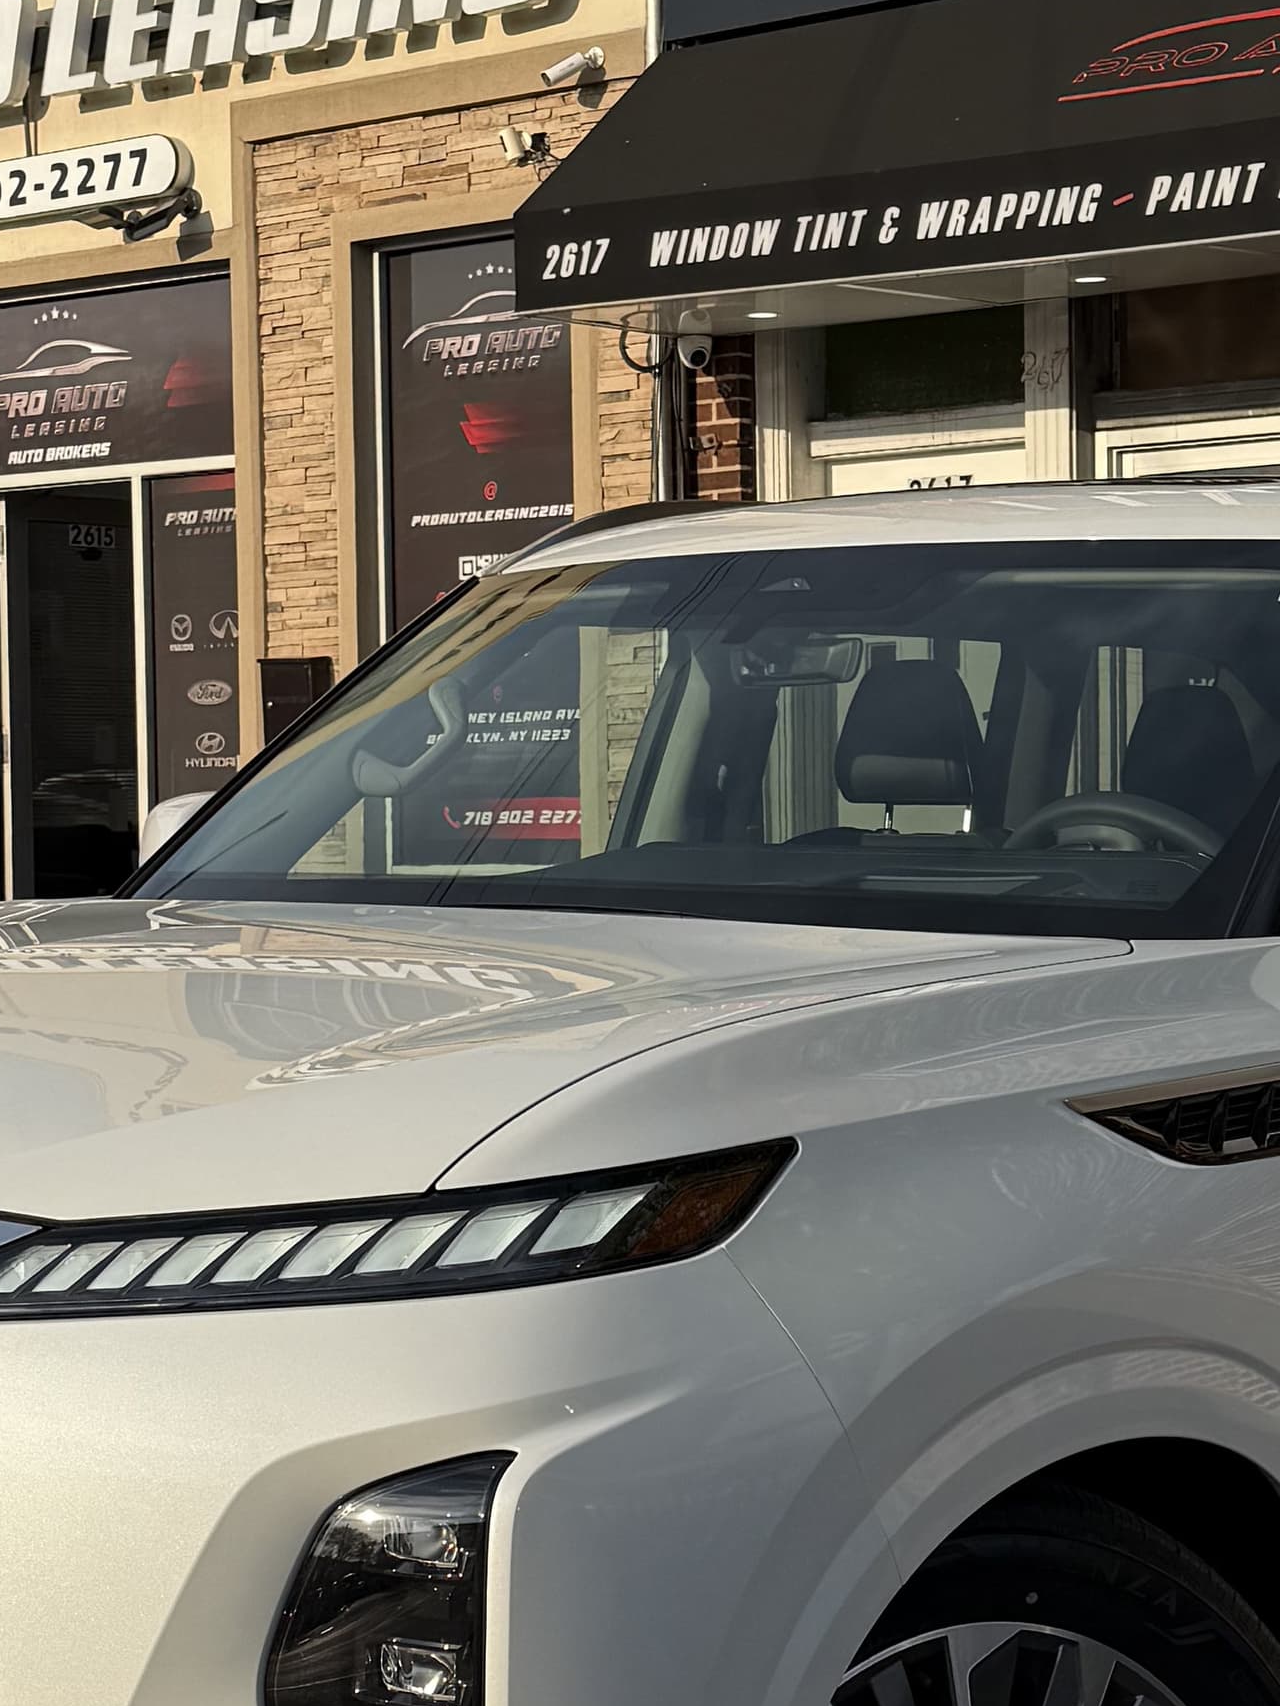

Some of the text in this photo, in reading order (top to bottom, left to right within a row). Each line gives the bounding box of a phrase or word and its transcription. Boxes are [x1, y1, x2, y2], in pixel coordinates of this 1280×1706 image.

[1072, 41, 1229, 84] PRO
[541, 237, 612, 281] 2617
[649, 218, 782, 269] WINDOW
[793, 208, 868, 254] TINT
[878, 205, 902, 245] &
[916, 183, 1103, 240] WRAPPING
[1144, 161, 1267, 216] PAINT
[423, 324, 563, 362] PRO AUTO
[443, 355, 541, 378] LEASING
[51, 380, 128, 413] AUTO
[10, 415, 107, 439] LEASING
[7, 442, 111, 465] AUTO BROKERS
[165, 507, 237, 526] PRO AUT
[411, 504, 574, 527] PROAUTOLEASING2615
[70, 524, 114, 547] 2615
[500, 710, 552, 723] ISLAND
[509, 730, 527, 741] NY
[531, 729, 571, 741] 11223
[463, 811, 493, 825] 718
[496, 810, 534, 824] 902
